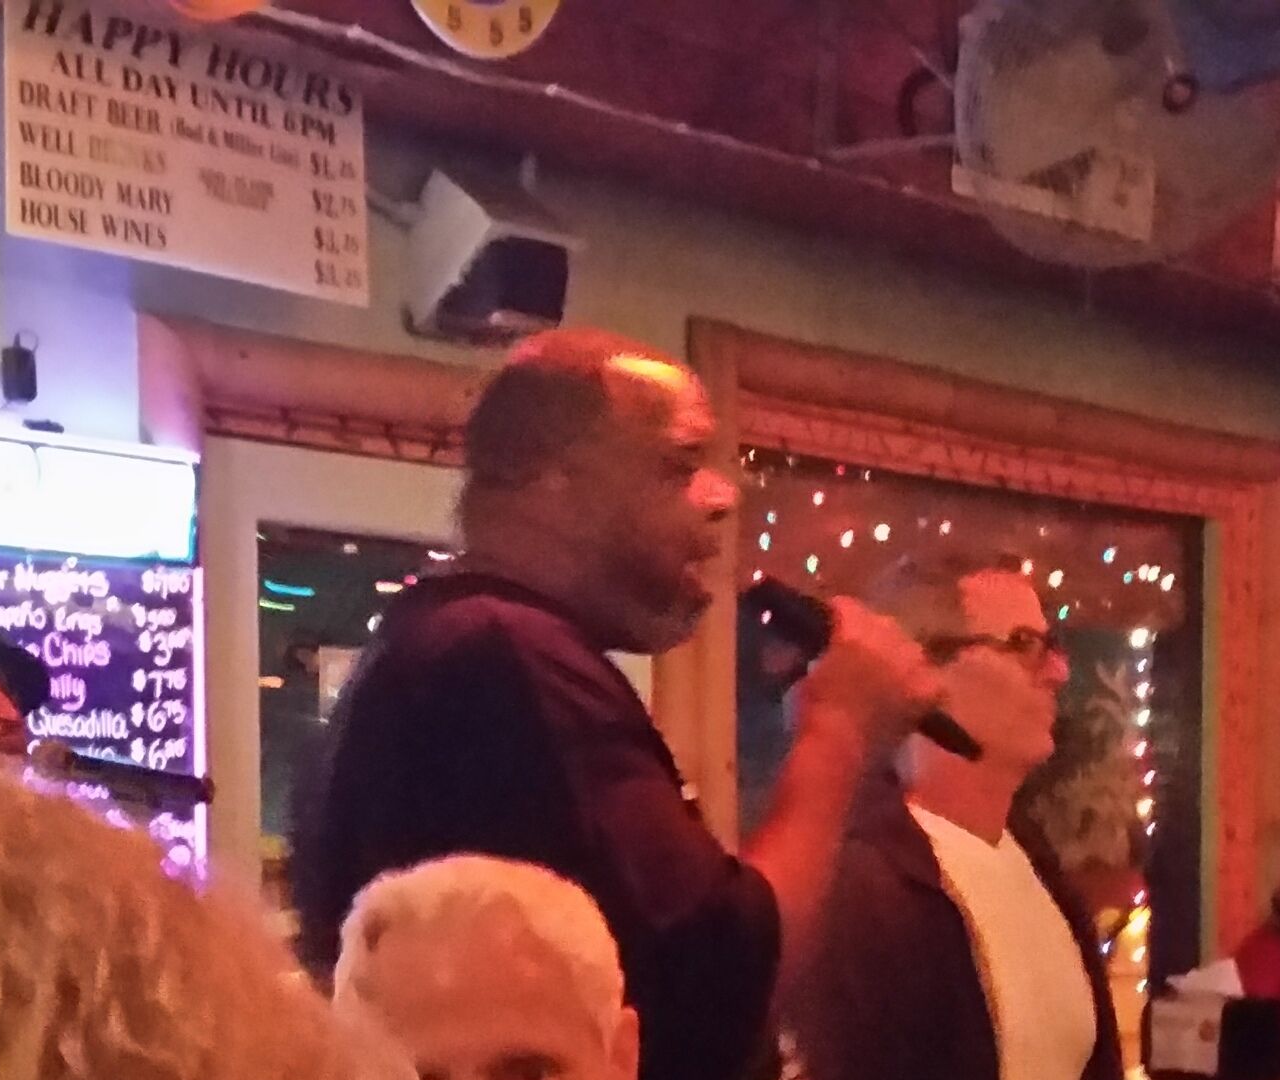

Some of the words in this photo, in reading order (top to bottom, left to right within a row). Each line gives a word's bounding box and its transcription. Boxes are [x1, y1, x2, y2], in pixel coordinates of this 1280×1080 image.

[23, 0, 180, 66] HAPPY
[207, 43, 353, 117] HOURS
[19, 80, 98, 118] DRAFT
[107, 98, 160, 133] BEER
[52, 51, 112, 86] ALL
[123, 66, 176, 102] DAY
[191, 82, 272, 129] UNTIL
[283, 111, 336, 145] 6PM
[19, 120, 76, 157] WELL
[20, 162, 104, 201] BLOODY
[117, 181, 172, 216] MARY
[20, 198, 88, 234] HOUSE
[102, 214, 167, 248] WINES
[43, 632, 111, 667] Chips
[27, 706, 129, 740] Quesadilla
